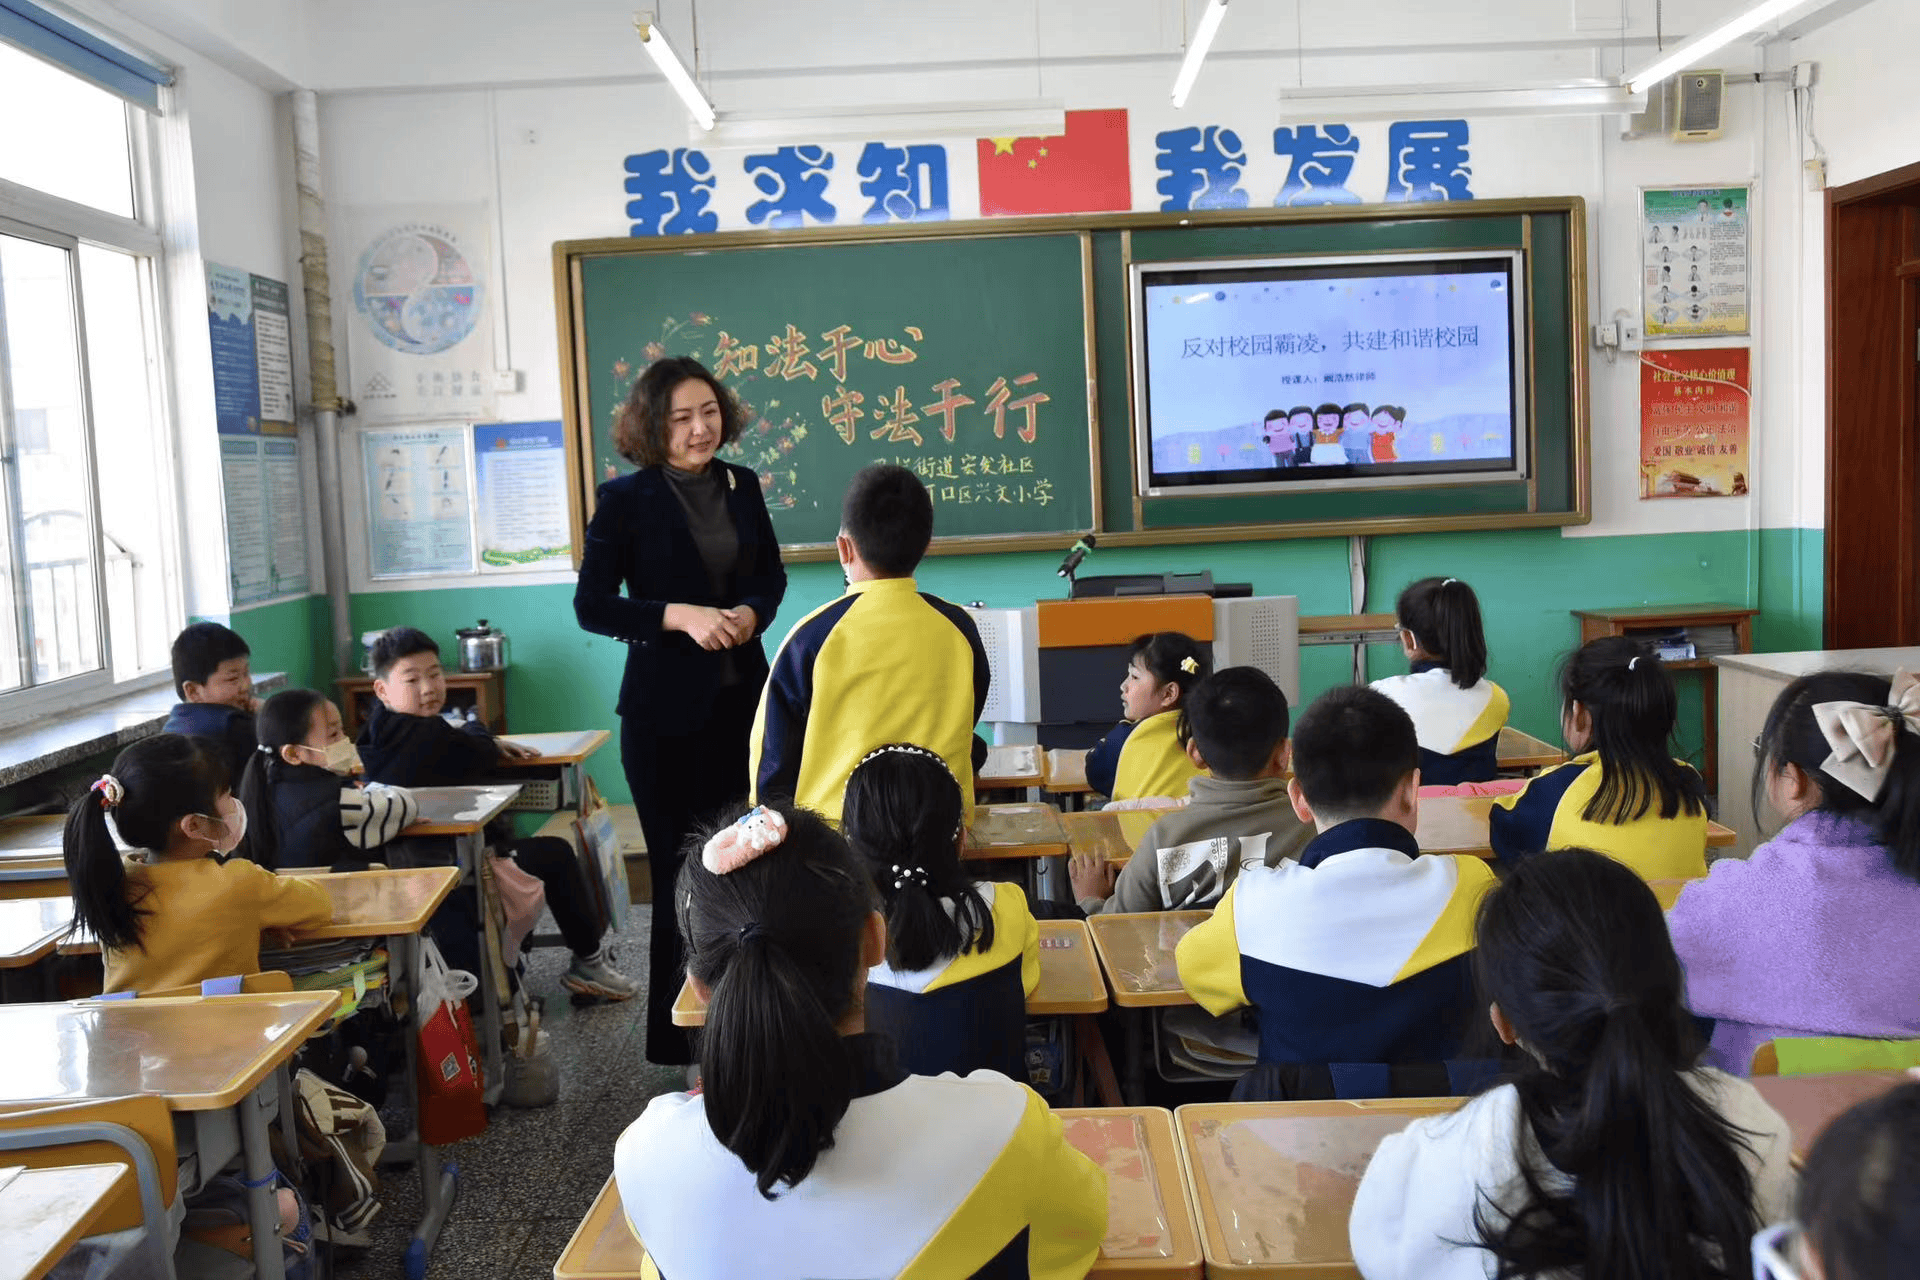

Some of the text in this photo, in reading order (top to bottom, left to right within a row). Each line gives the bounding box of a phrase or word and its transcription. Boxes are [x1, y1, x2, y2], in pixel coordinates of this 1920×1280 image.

[623, 119, 1474, 238] 我求知 我发展
[712, 323, 925, 383] 知法于心
[1181, 325, 1479, 359] 反对校园霸凌，共建和谐校园
[821, 372, 1051, 447] 守法于行
